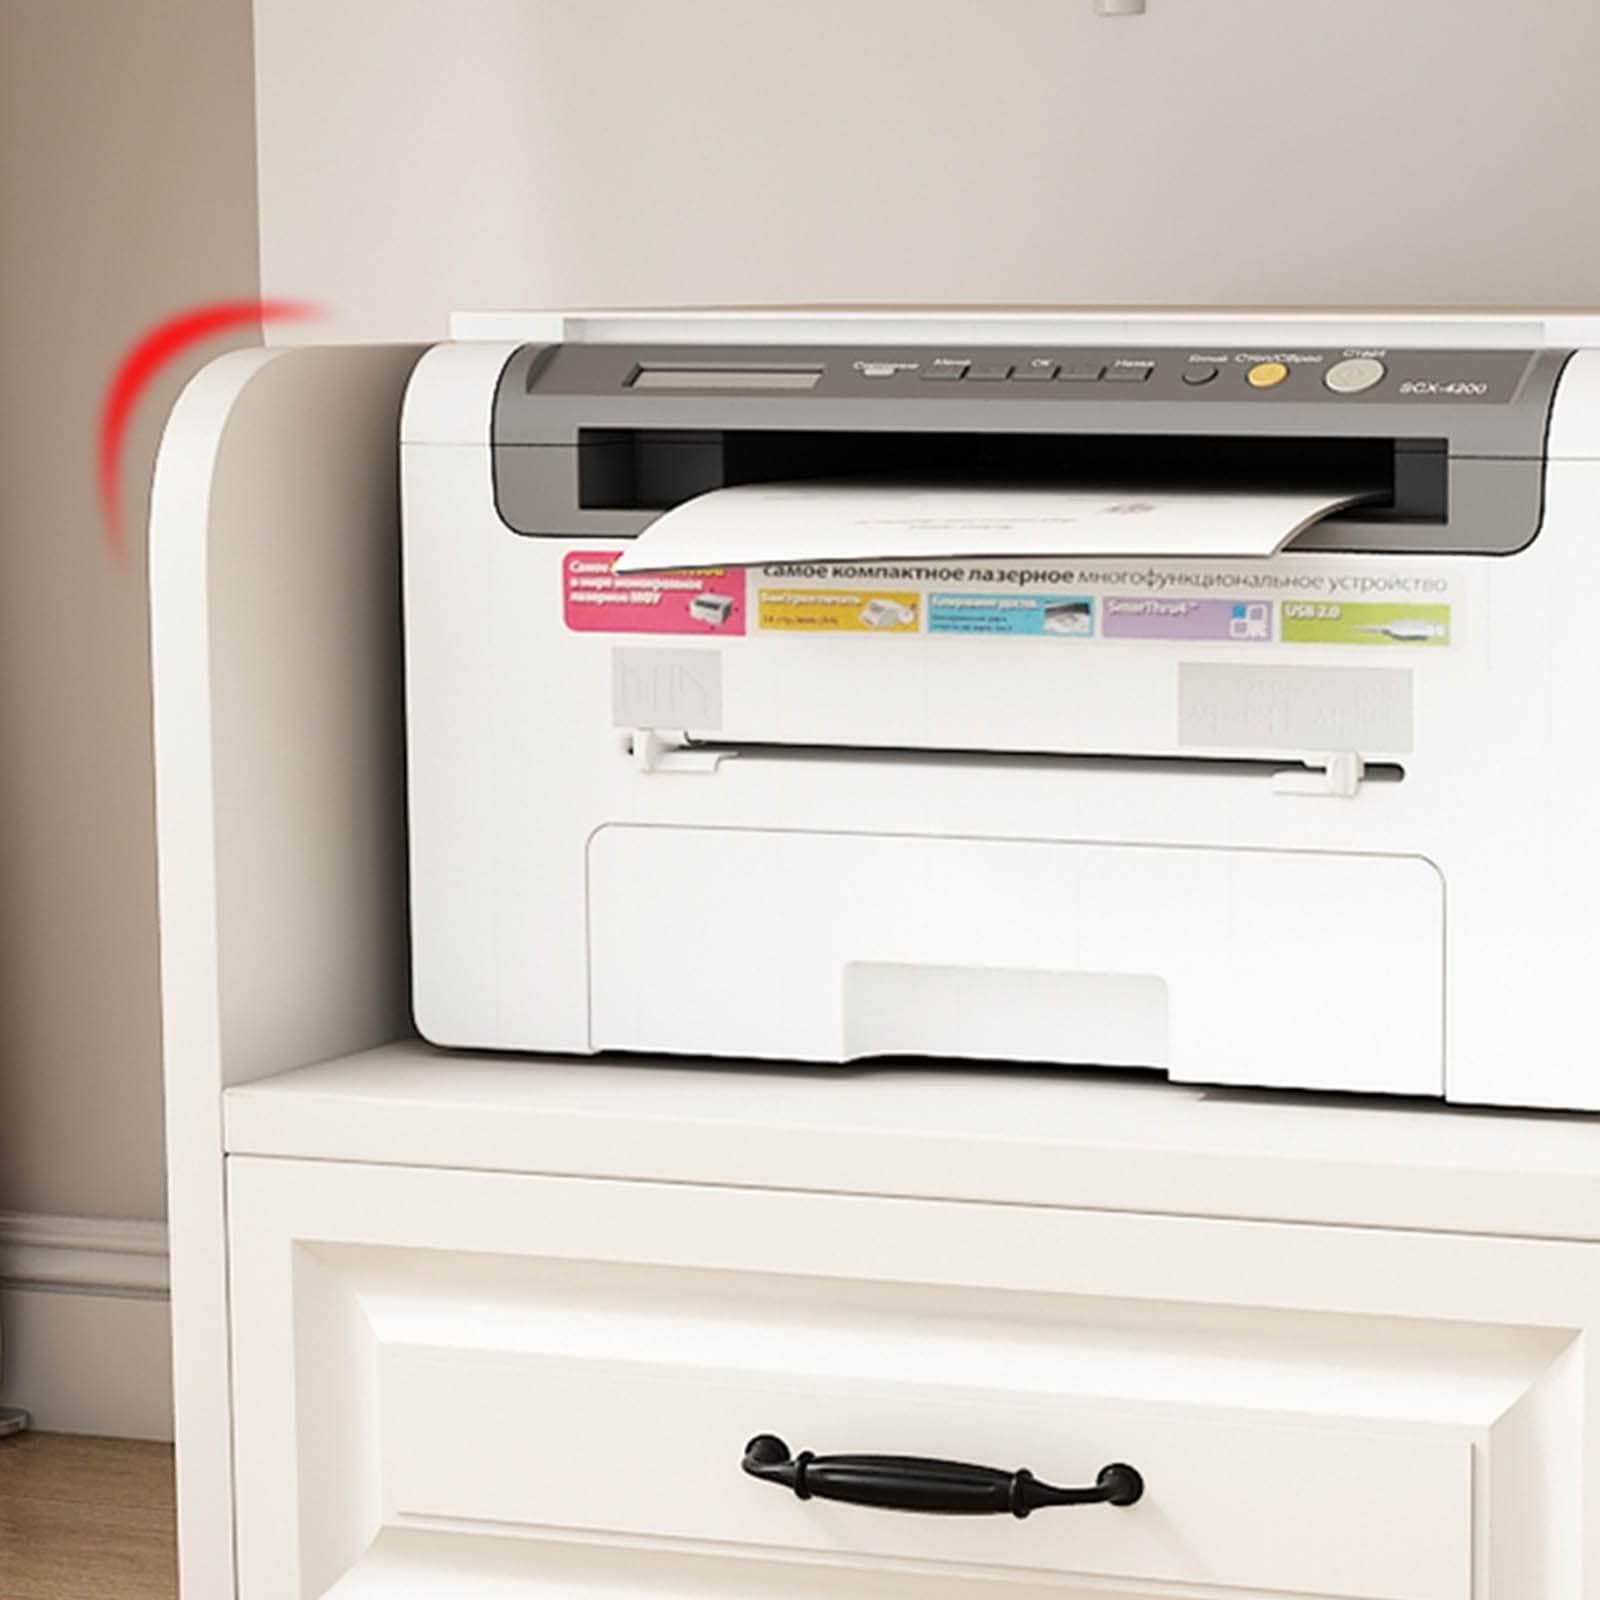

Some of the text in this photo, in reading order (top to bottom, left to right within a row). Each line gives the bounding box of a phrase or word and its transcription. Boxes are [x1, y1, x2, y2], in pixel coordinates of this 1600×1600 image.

[1399, 381, 1488, 395] SCX-4200
[762, 565, 1449, 593] самое компактное лазерное многофункциональное устройство
[1284, 603, 1342, 620] USB 2.0
